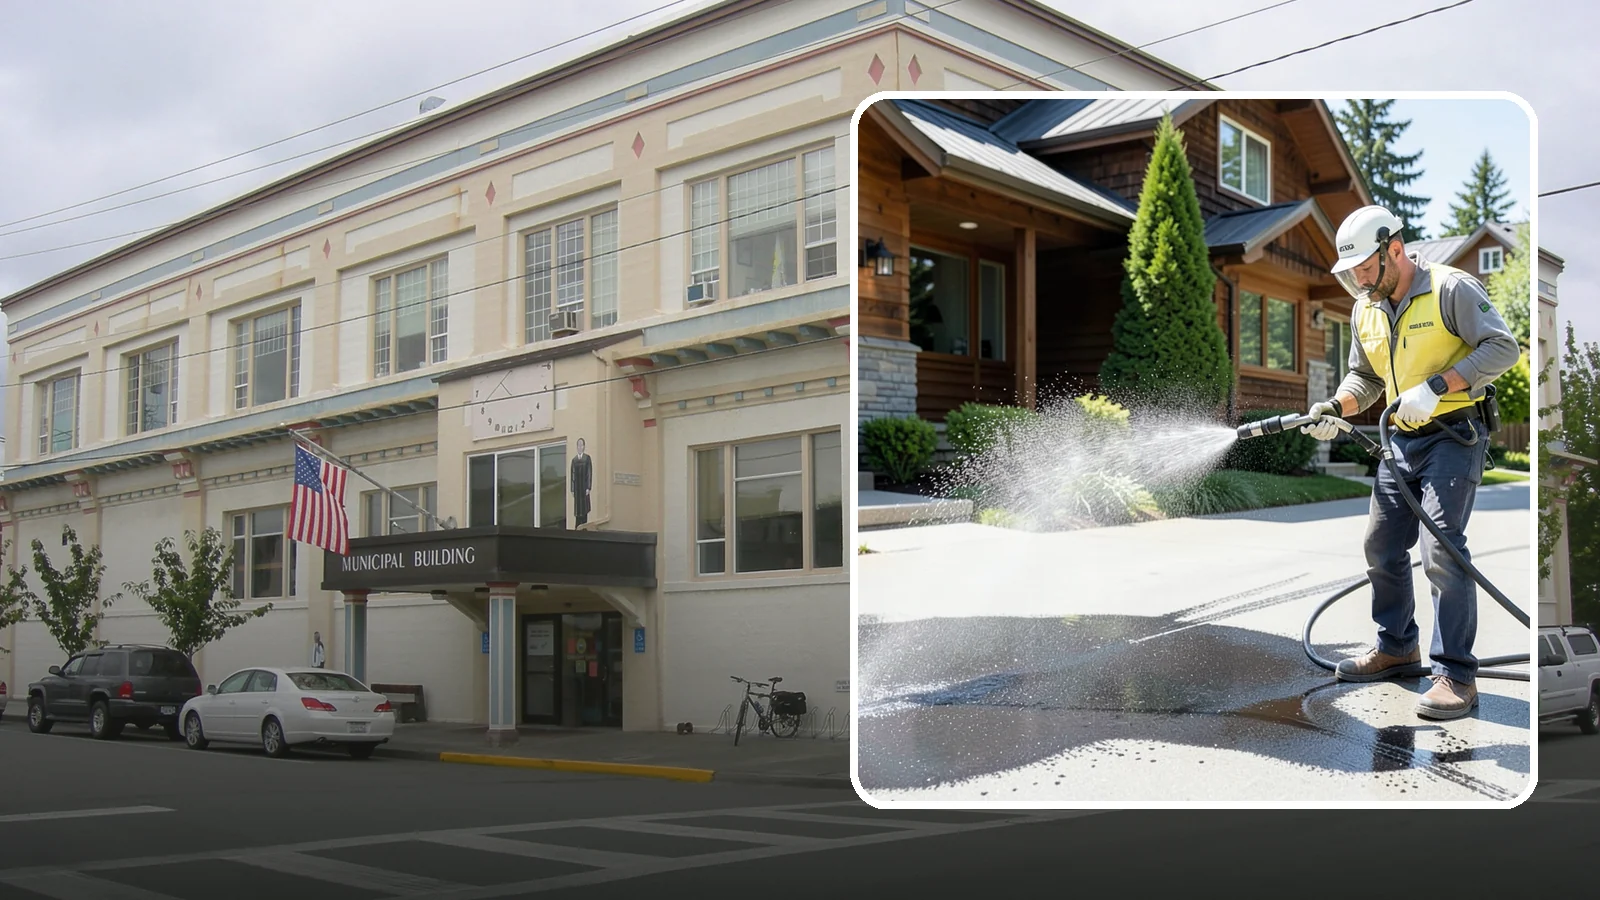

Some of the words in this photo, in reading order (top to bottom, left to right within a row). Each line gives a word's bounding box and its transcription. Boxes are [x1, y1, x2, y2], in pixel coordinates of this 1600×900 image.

[495, 423, 500, 432] 10
[507, 425, 513, 433] 12
[342, 552, 406, 572] MUNICIPAL
[414, 546, 475, 567] BUILDING
